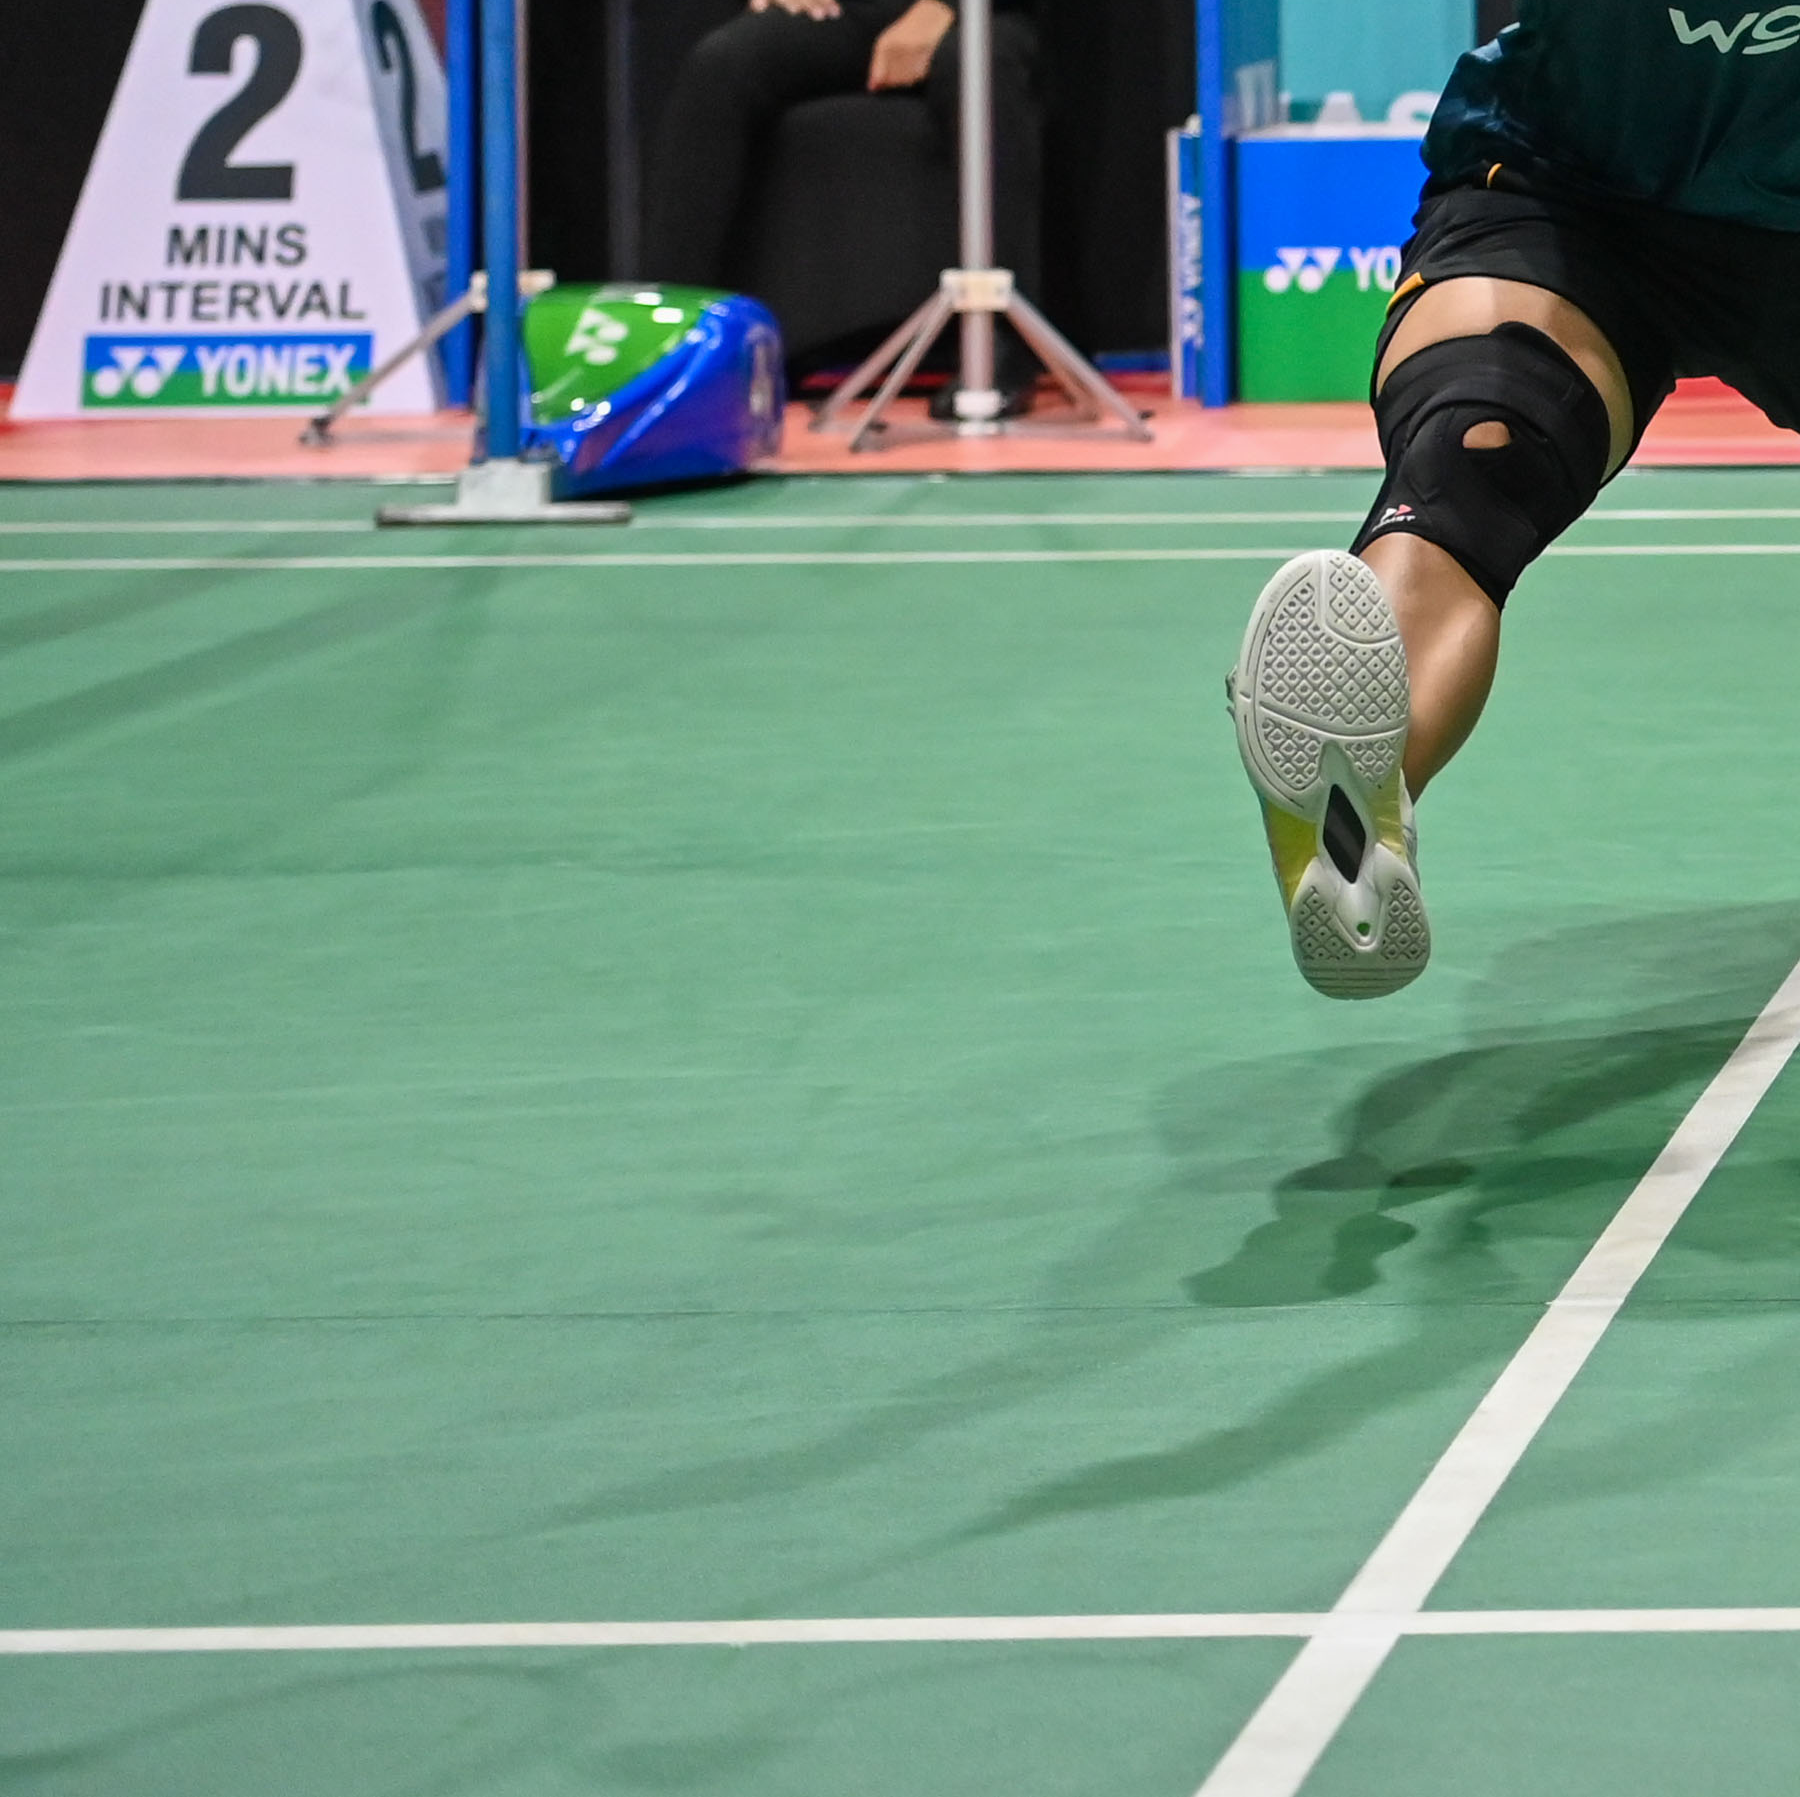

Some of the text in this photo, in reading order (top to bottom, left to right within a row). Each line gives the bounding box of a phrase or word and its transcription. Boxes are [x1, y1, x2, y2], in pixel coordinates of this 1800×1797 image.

[176, 1, 304, 202] 2
[167, 224, 308, 267] MINS
[100, 279, 366, 321] INTERVAL
[194, 344, 358, 397] YONEX
